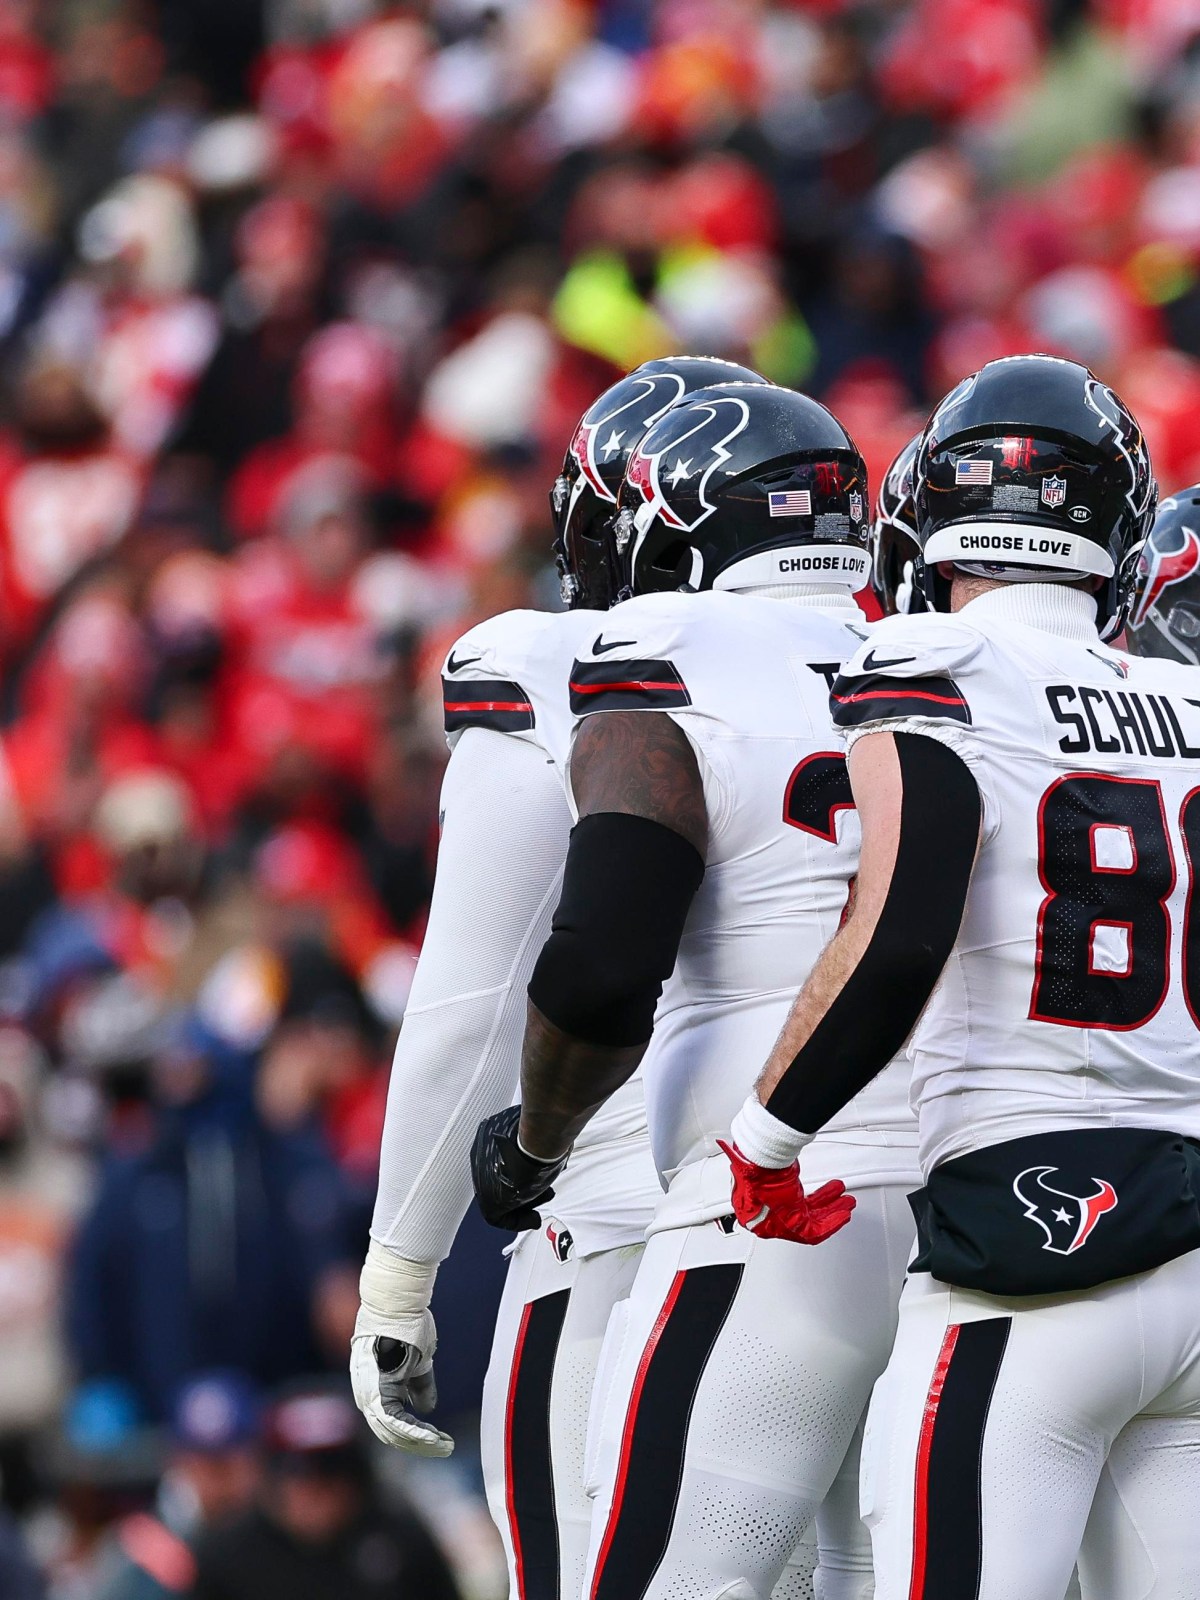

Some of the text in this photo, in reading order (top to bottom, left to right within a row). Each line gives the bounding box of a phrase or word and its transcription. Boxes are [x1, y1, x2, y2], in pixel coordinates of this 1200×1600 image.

[1045, 489, 1062, 502] NFL
[960, 536, 1072, 556] CHOOSE LOVE
[779, 557, 865, 573] CHOOSE LOVE
